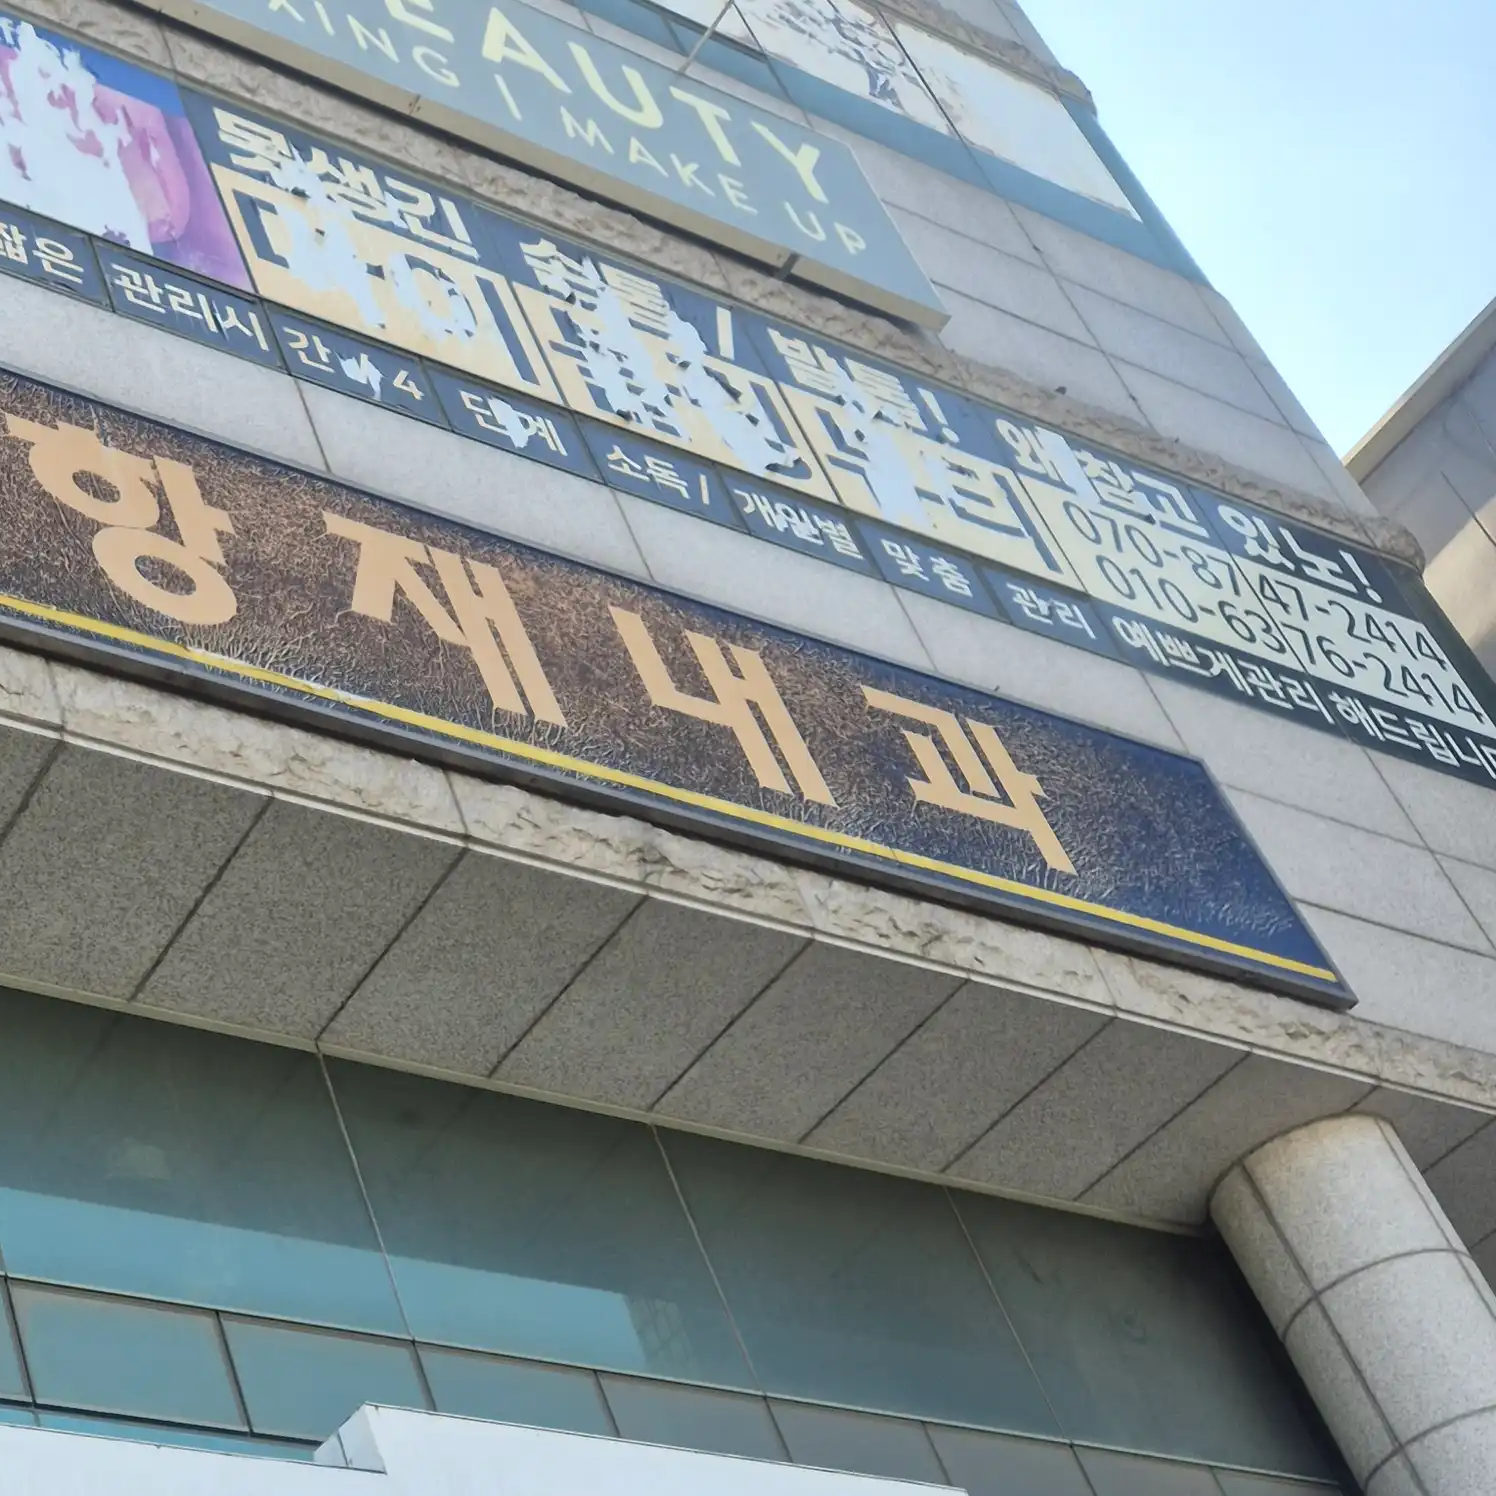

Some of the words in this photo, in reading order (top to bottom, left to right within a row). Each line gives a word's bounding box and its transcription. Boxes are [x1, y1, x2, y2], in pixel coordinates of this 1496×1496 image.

[560, 105, 758, 217] MAKE
[785, 201, 867, 255] UP
[1006, 582, 1098, 640] 관리
[1062, 499, 1449, 672] 070-8747-2414
[1095, 554, 1485, 725] 010-6376-2414
